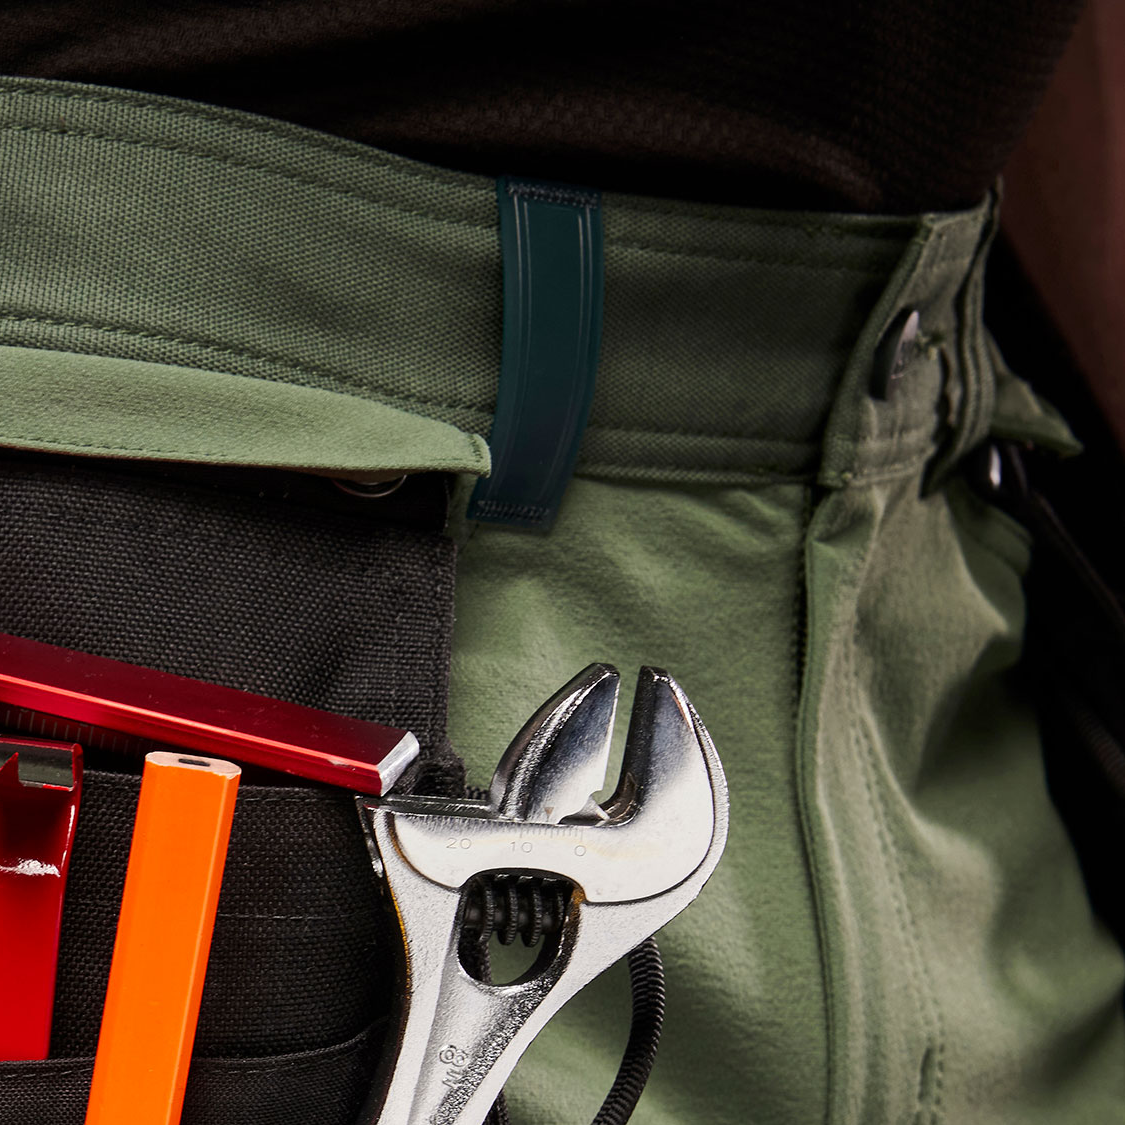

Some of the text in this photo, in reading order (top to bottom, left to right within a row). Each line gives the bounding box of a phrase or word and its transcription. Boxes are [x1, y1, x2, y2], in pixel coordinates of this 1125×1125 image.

[445, 837, 587, 857] 20 10 0
